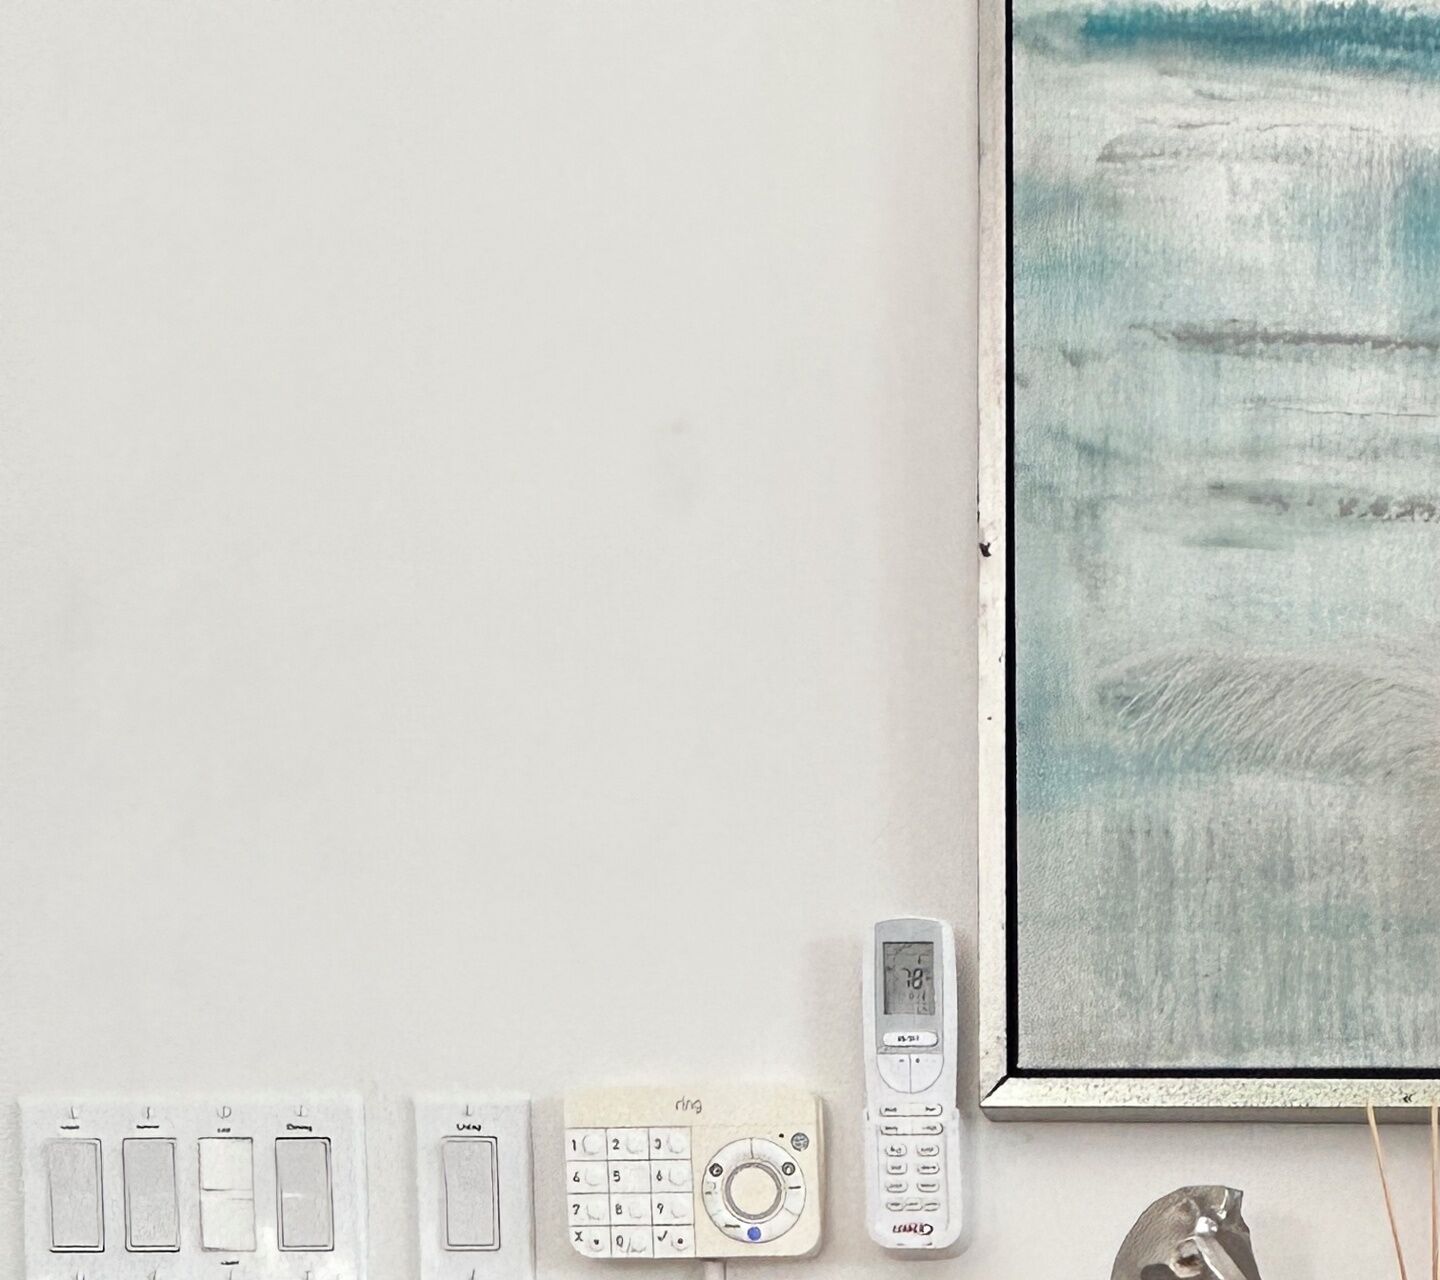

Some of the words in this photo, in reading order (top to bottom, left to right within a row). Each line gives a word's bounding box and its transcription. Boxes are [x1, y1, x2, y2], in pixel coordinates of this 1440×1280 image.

[675, 1096, 702, 1114] ring
[611, 1138, 620, 1151] 2
[612, 1170, 621, 1182] 5
